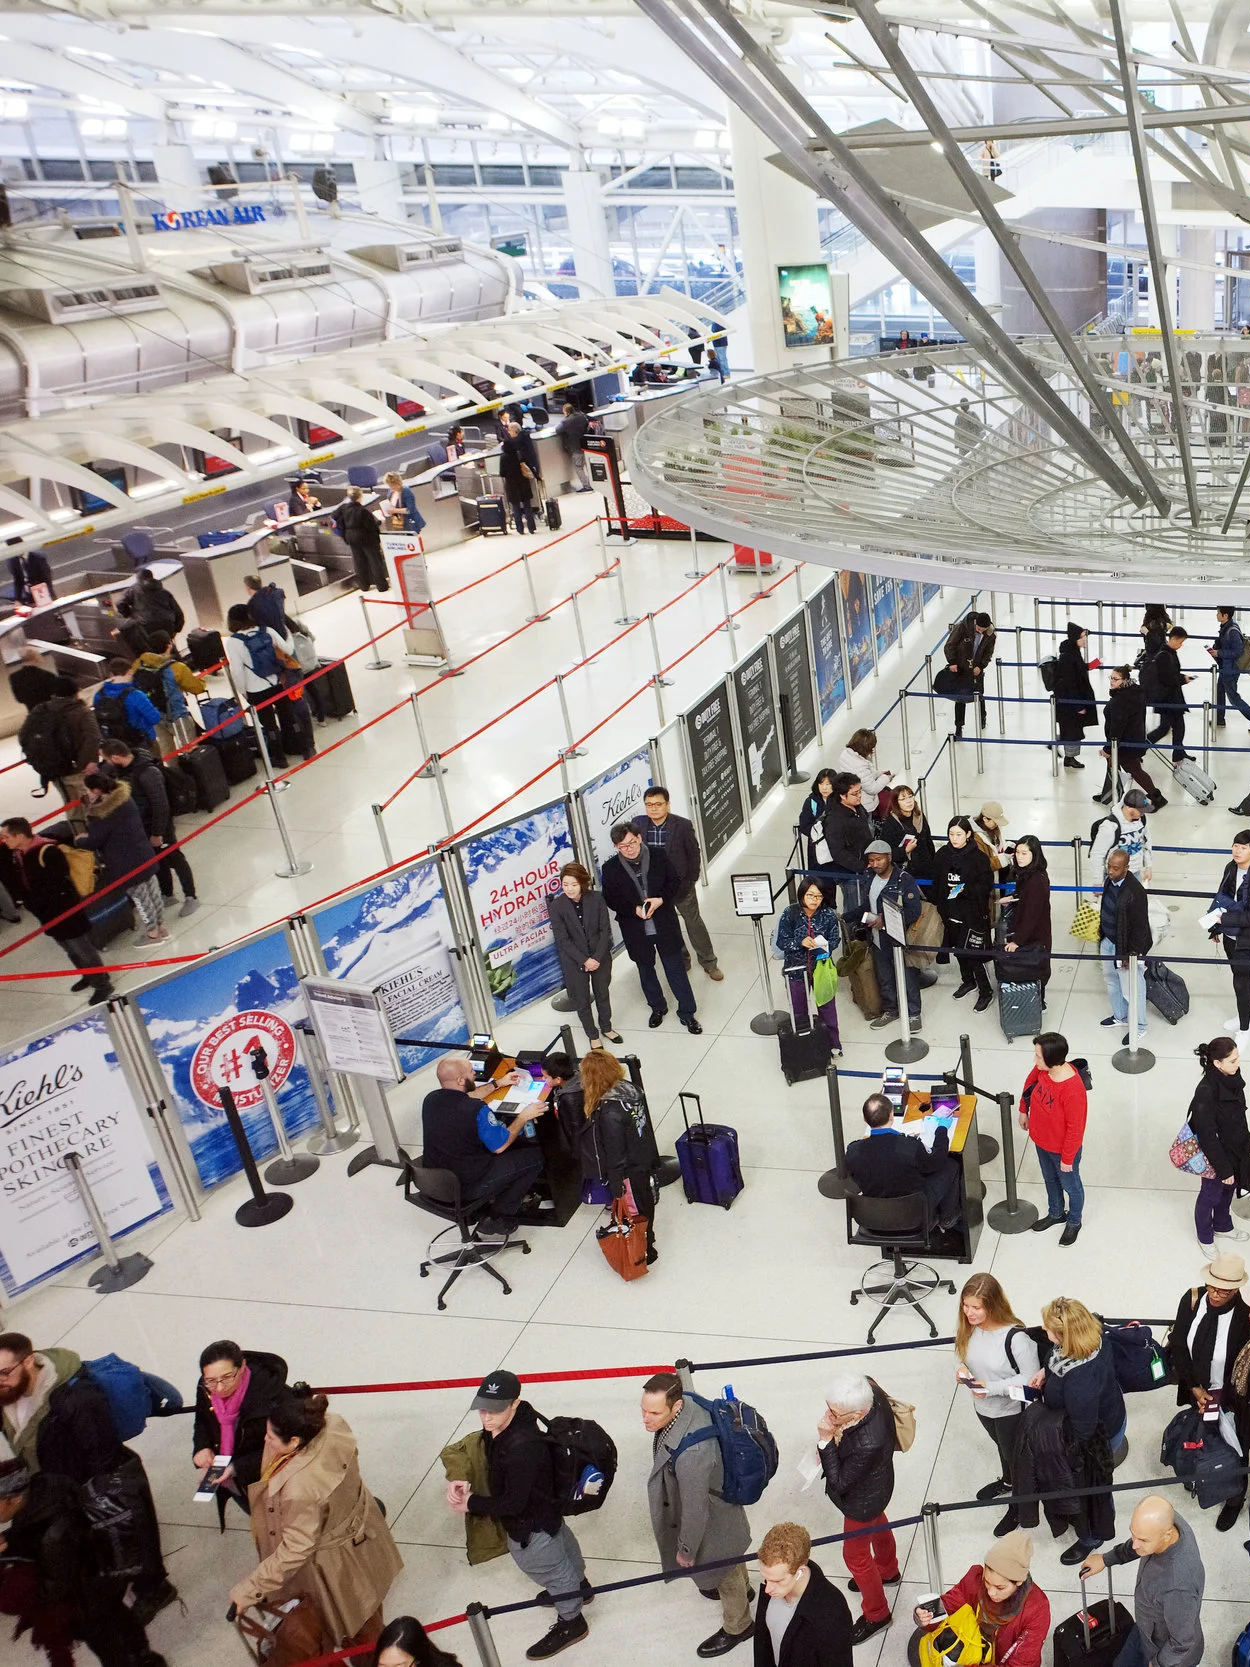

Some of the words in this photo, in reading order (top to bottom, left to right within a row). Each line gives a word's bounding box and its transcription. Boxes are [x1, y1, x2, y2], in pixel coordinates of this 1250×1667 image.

[152, 208, 230, 231] KOREAN
[233, 205, 266, 224] AIR
[746, 664, 755, 681] DUTY
[753, 657, 763, 673] FREE
[701, 706, 712, 724] DUTY
[710, 697, 721, 715] FREE
[602, 784, 642, 825] Kiehl's
[480, 878, 562, 928] HYDRATIO
[490, 860, 559, 905] 24-HOUR
[493, 942, 519, 960] ULTRA
[520, 926, 548, 946] FACIAL
[387, 984, 416, 1003] FACIAL
[418, 969, 443, 987] CREAM
[196, 1047, 214, 1075] OUR
[208, 1020, 236, 1046] BEST
[239, 1015, 285, 1036] SELLING
[0, 1110, 121, 1181] POTHECARY
[7, 1110, 84, 1158] FINEST
